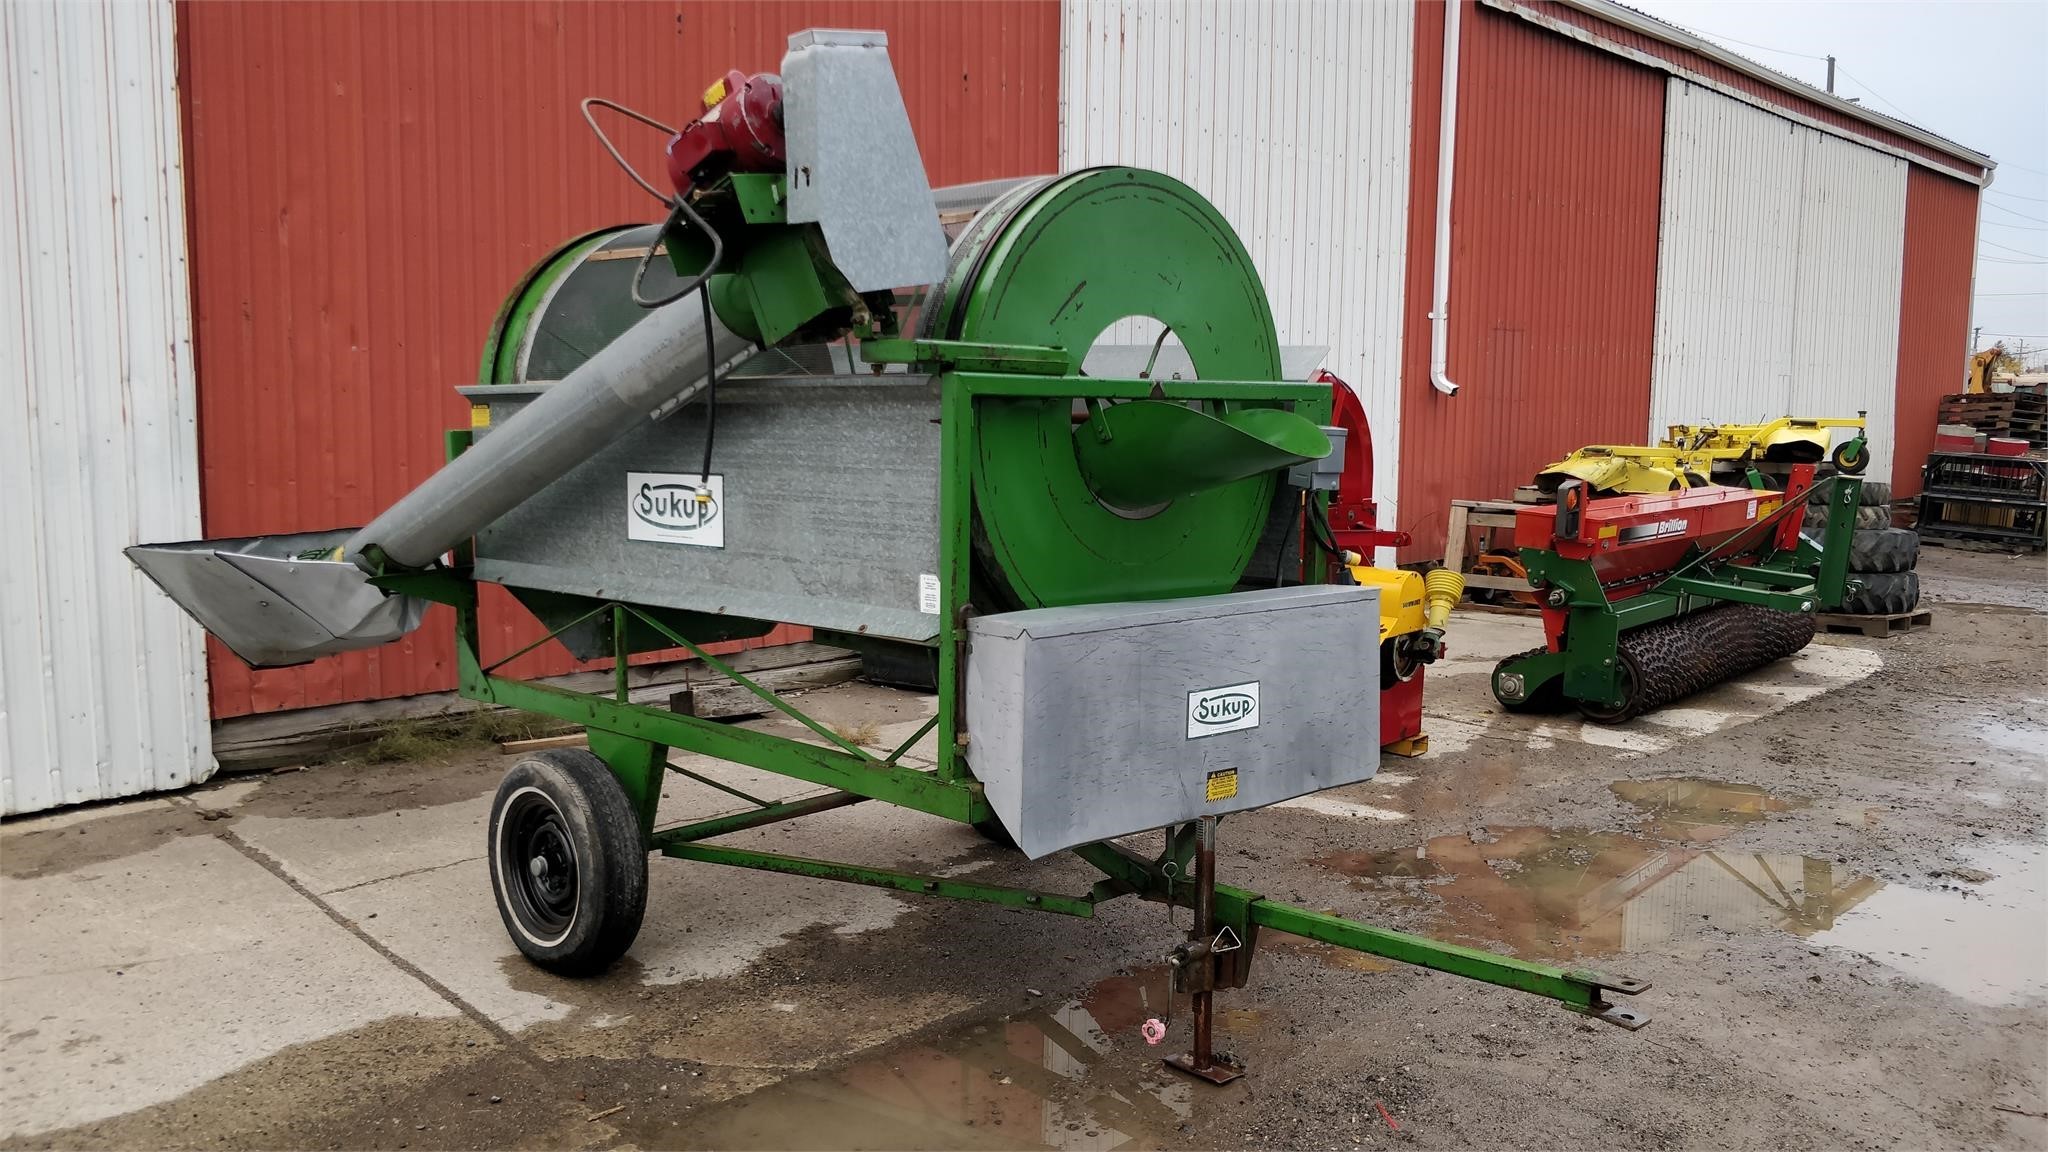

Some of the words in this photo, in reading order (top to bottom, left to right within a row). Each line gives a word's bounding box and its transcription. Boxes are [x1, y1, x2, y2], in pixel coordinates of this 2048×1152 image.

[641, 483, 708, 528] Sukup
[1658, 519, 1688, 534] Brillion
[1199, 697, 1250, 719] Sukup
